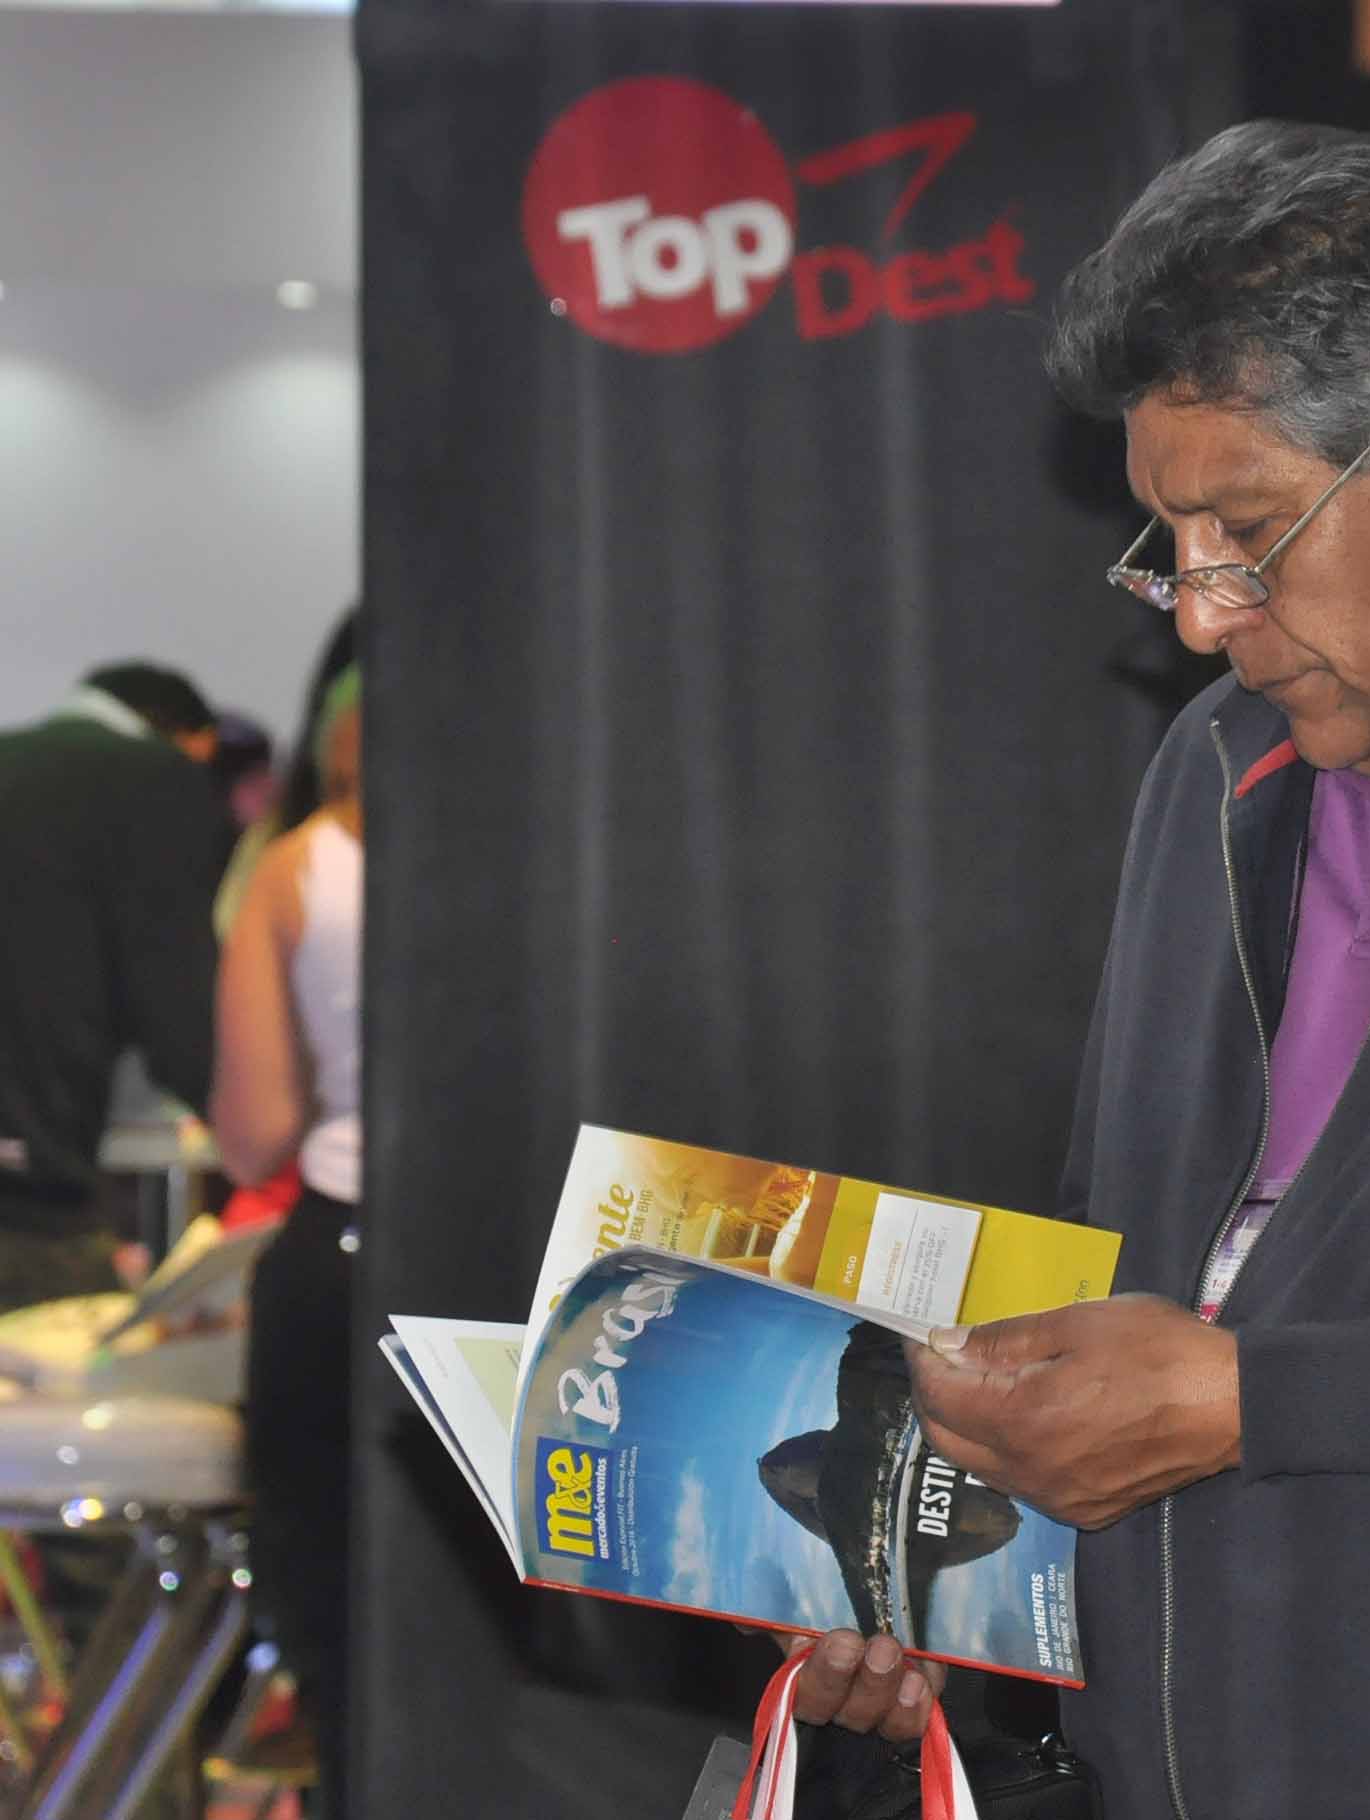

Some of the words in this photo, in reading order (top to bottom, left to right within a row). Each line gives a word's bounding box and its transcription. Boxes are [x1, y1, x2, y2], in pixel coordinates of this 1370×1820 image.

[557, 195, 793, 317] Top
[795, 218, 1035, 341] Dest
[546, 1448, 595, 1557] m&e
[1031, 1572, 1052, 1668] SUPLEMENTOS
[1049, 1602, 1061, 1638] JANEIRO
